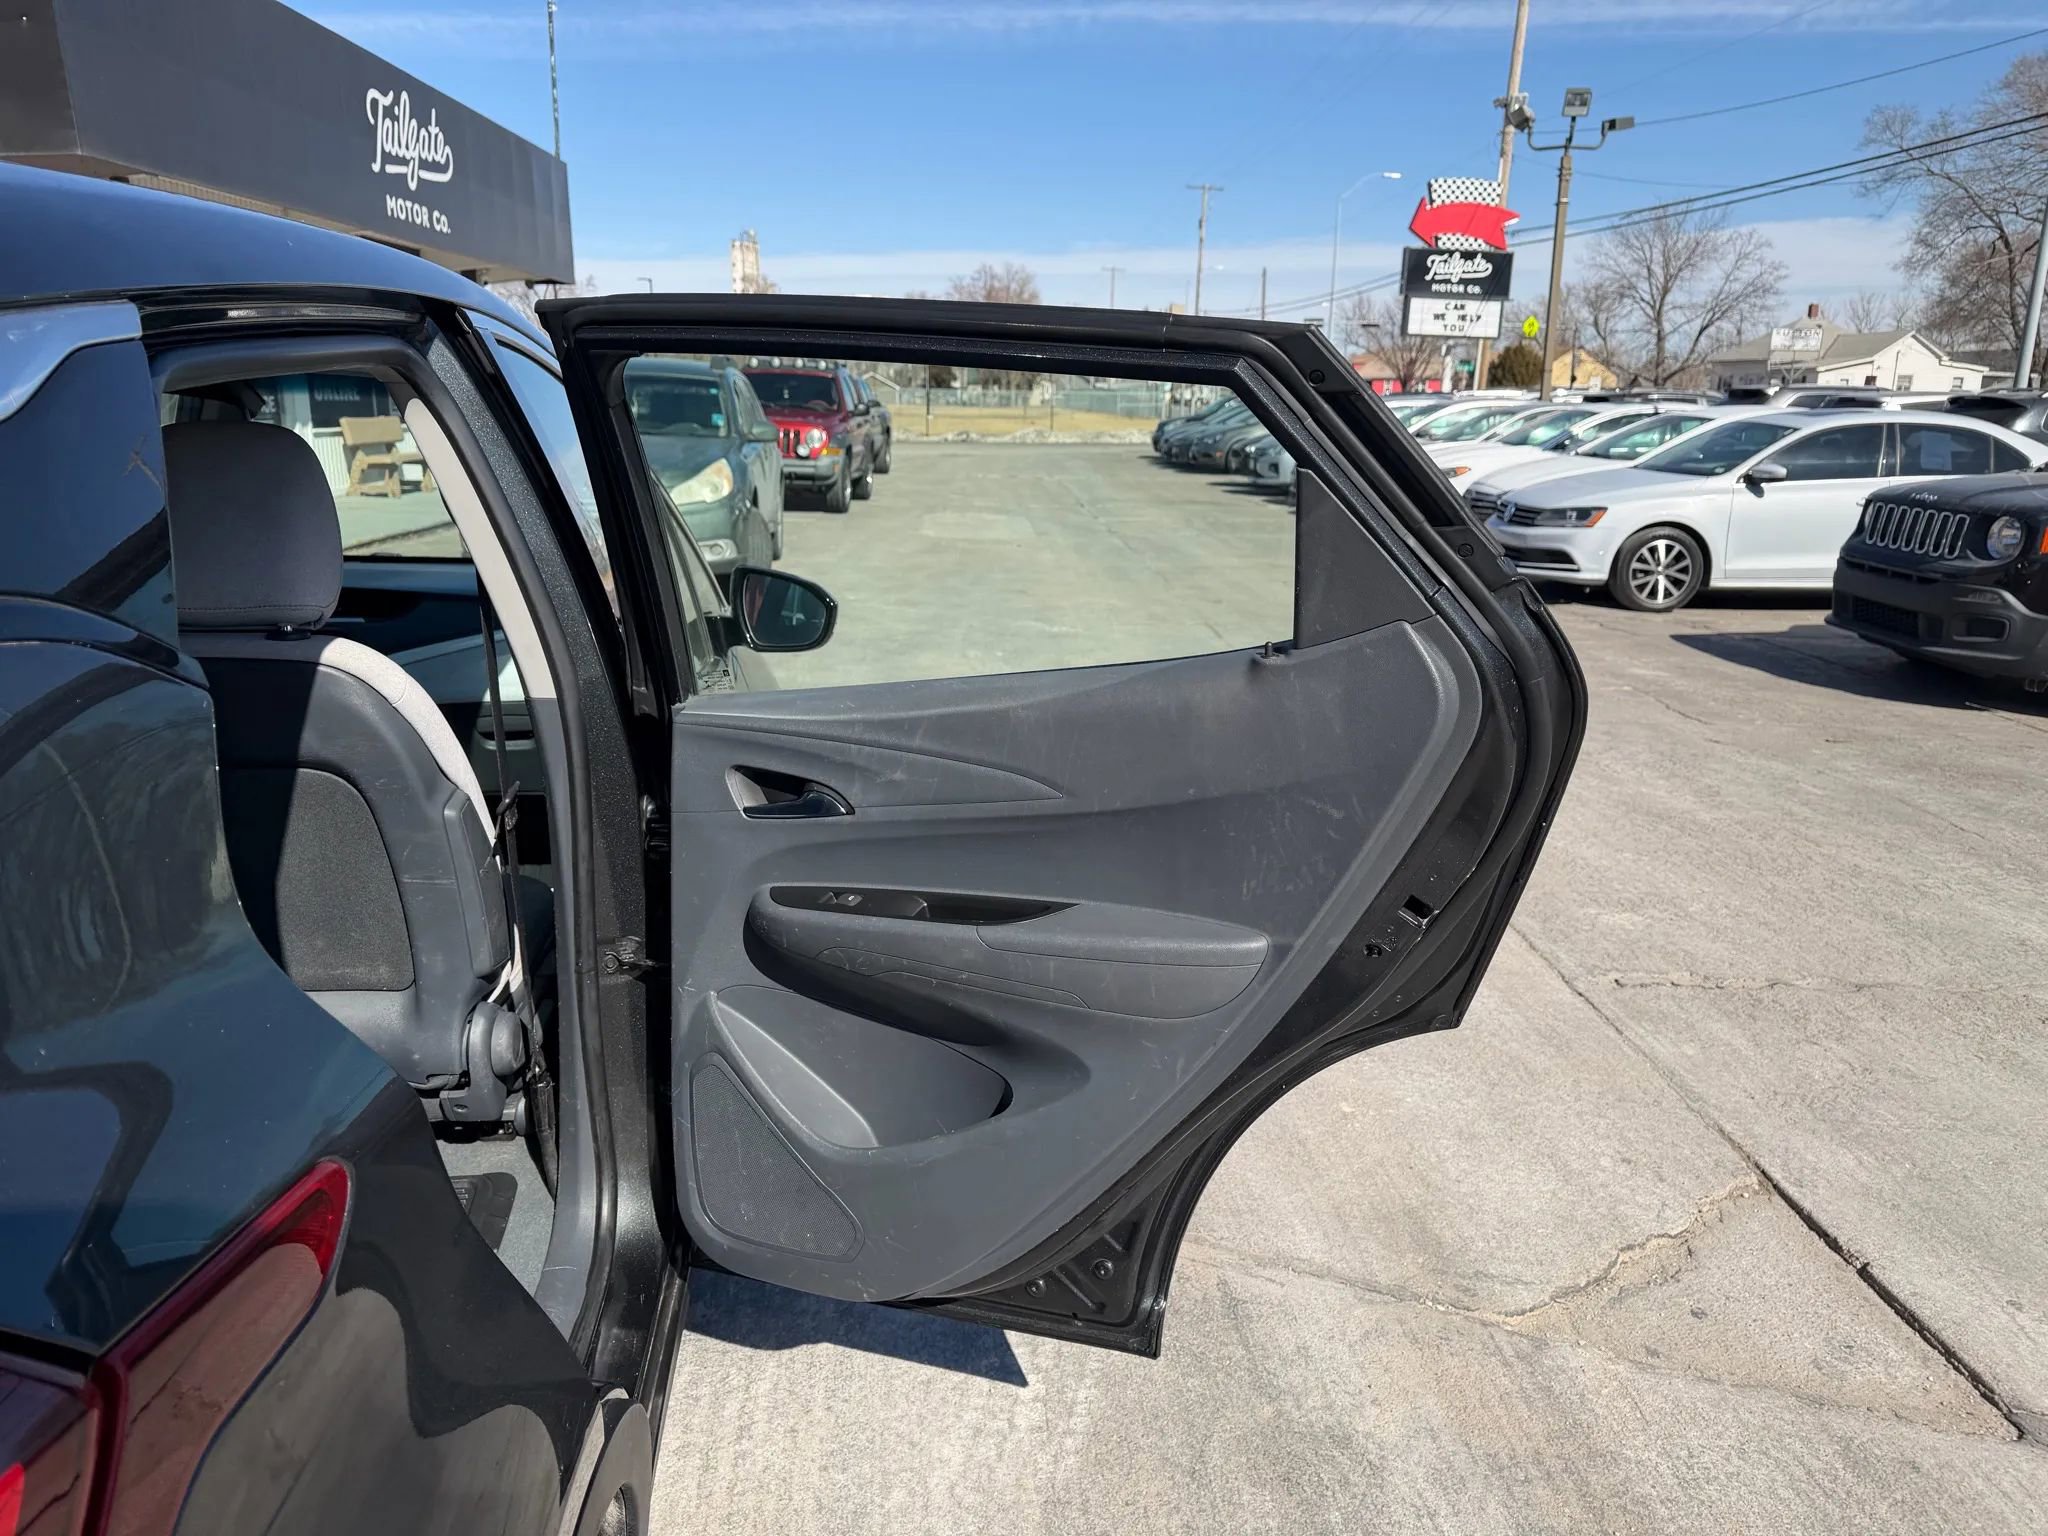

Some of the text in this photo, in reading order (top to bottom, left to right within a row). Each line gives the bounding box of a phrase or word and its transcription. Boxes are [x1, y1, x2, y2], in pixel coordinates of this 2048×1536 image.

[366, 88, 453, 191] Tailgate
[386, 194, 451, 234] MOTOR CO.
[1424, 251, 1493, 283] Tailgate
[1431, 283, 1465, 293] MOTOR
[1433, 313, 1446, 321] WE
[1445, 303, 1466, 311] CAN
